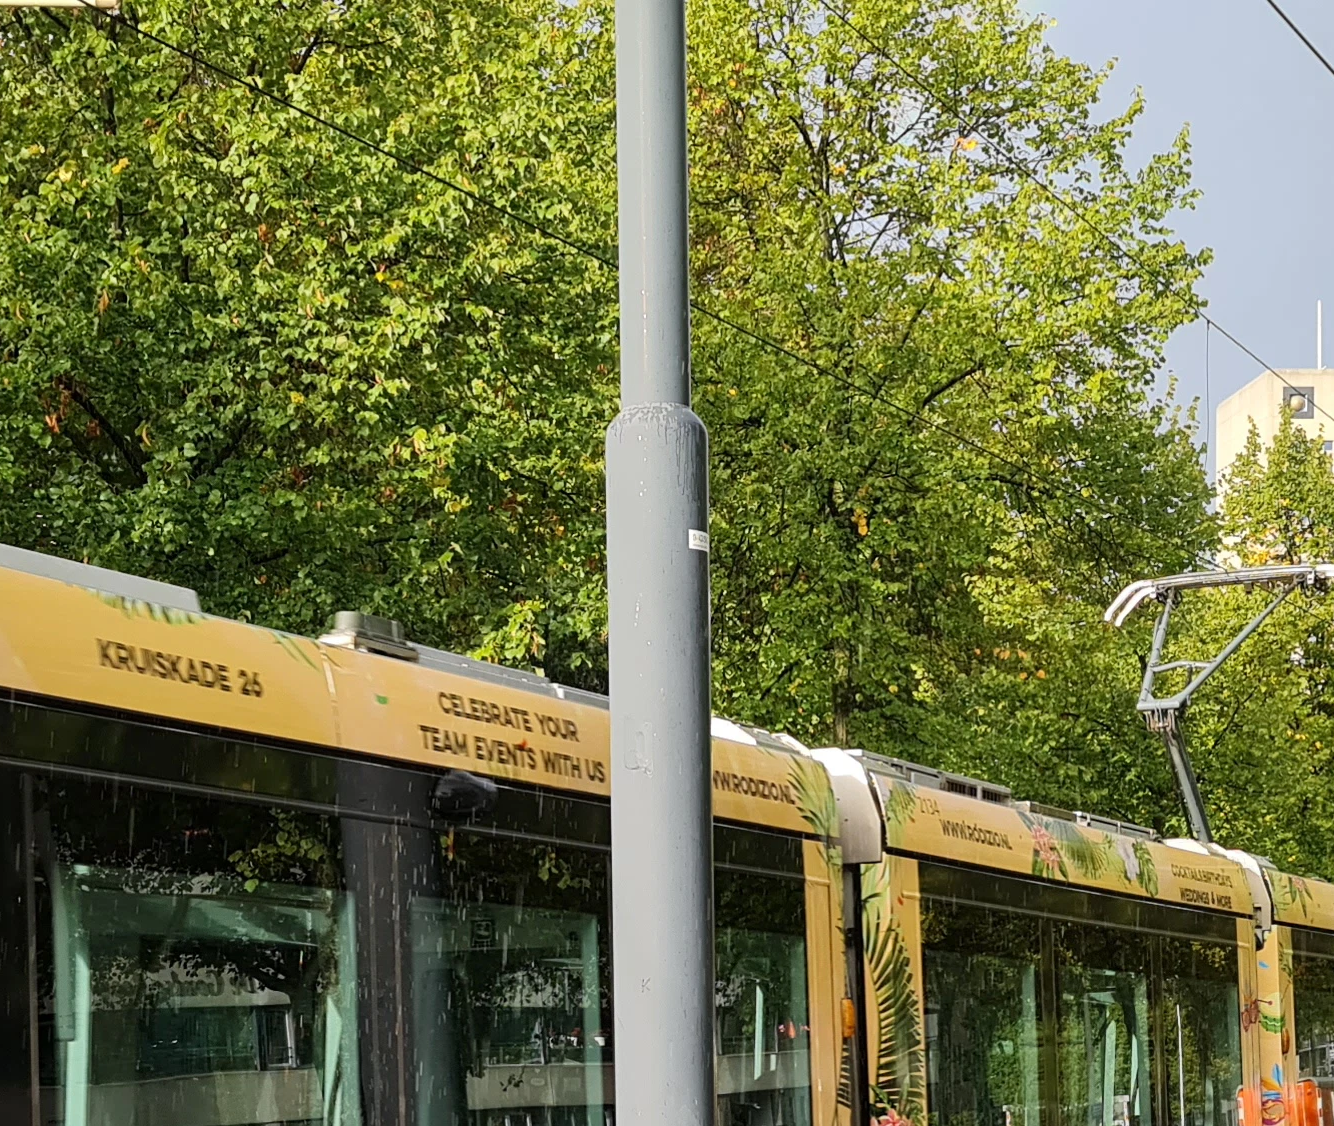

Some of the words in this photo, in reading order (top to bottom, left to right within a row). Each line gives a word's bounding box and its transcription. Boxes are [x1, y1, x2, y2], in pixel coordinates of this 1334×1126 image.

[97, 638, 233, 692] KRUISKADE
[238, 668, 263, 697] 26
[438, 691, 533, 732] CELEBRATE
[535, 713, 580, 742] YOUR
[419, 724, 469, 757] TEAM
[474, 736, 537, 770] EVENTS
[540, 750, 581, 779] WITH
[585, 757, 606, 783] US
